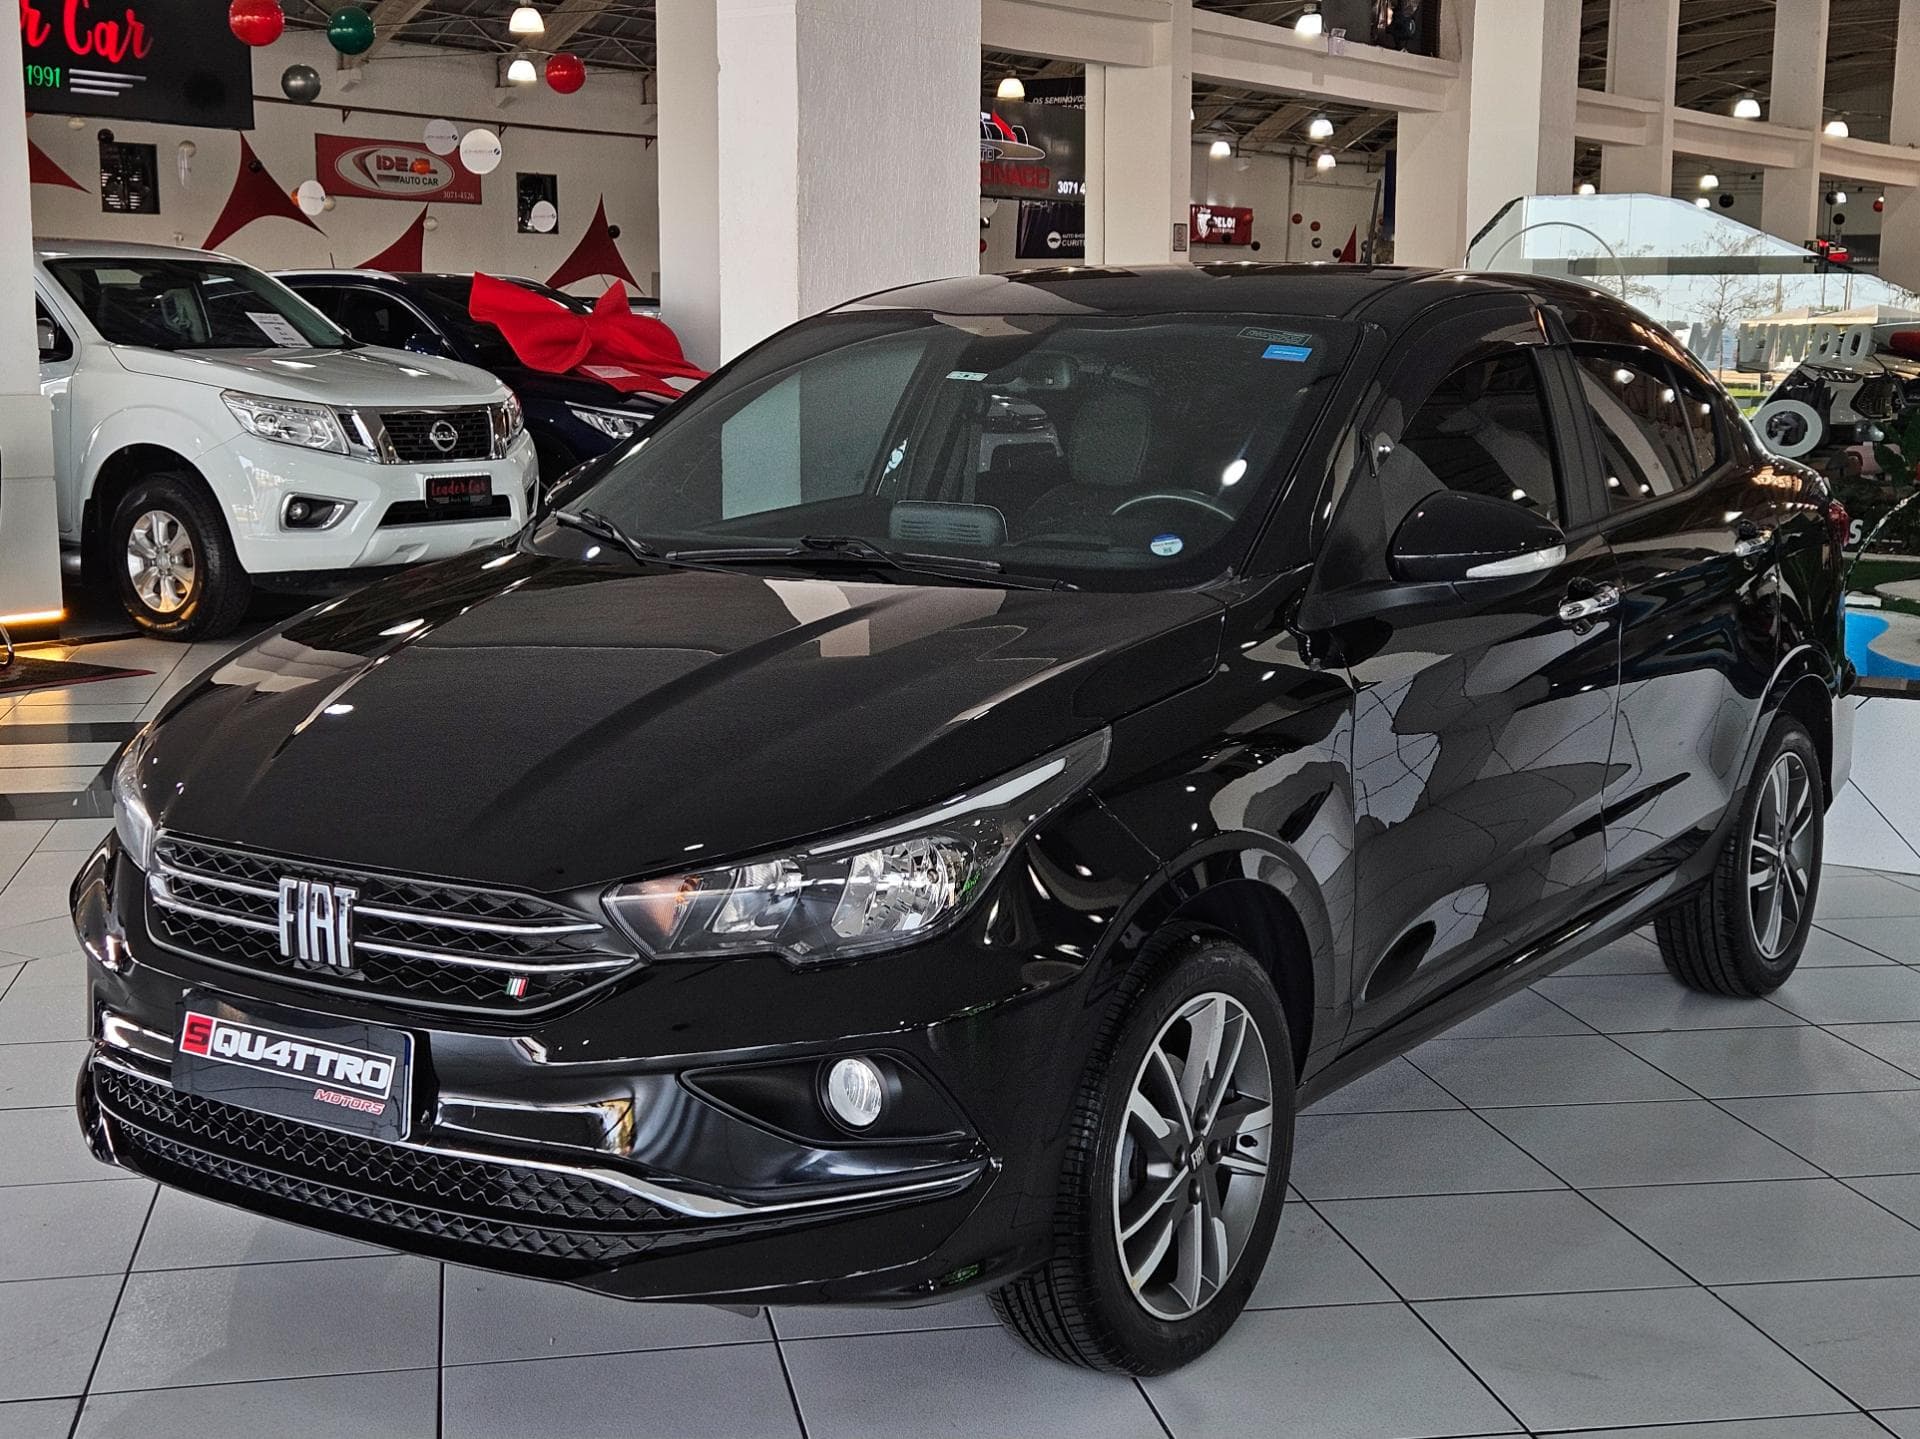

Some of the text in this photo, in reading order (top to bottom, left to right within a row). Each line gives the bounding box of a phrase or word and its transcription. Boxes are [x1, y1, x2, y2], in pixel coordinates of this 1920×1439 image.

[63, 0, 153, 63] Car
[26, 64, 61, 88] 1991
[400, 176, 439, 187] AUTO CAR
[1057, 181, 1079, 194] 3071
[1739, 322, 1872, 364] VINDO
[278, 876, 360, 969] FIAT
[313, 1088, 386, 1116] MOTORS
